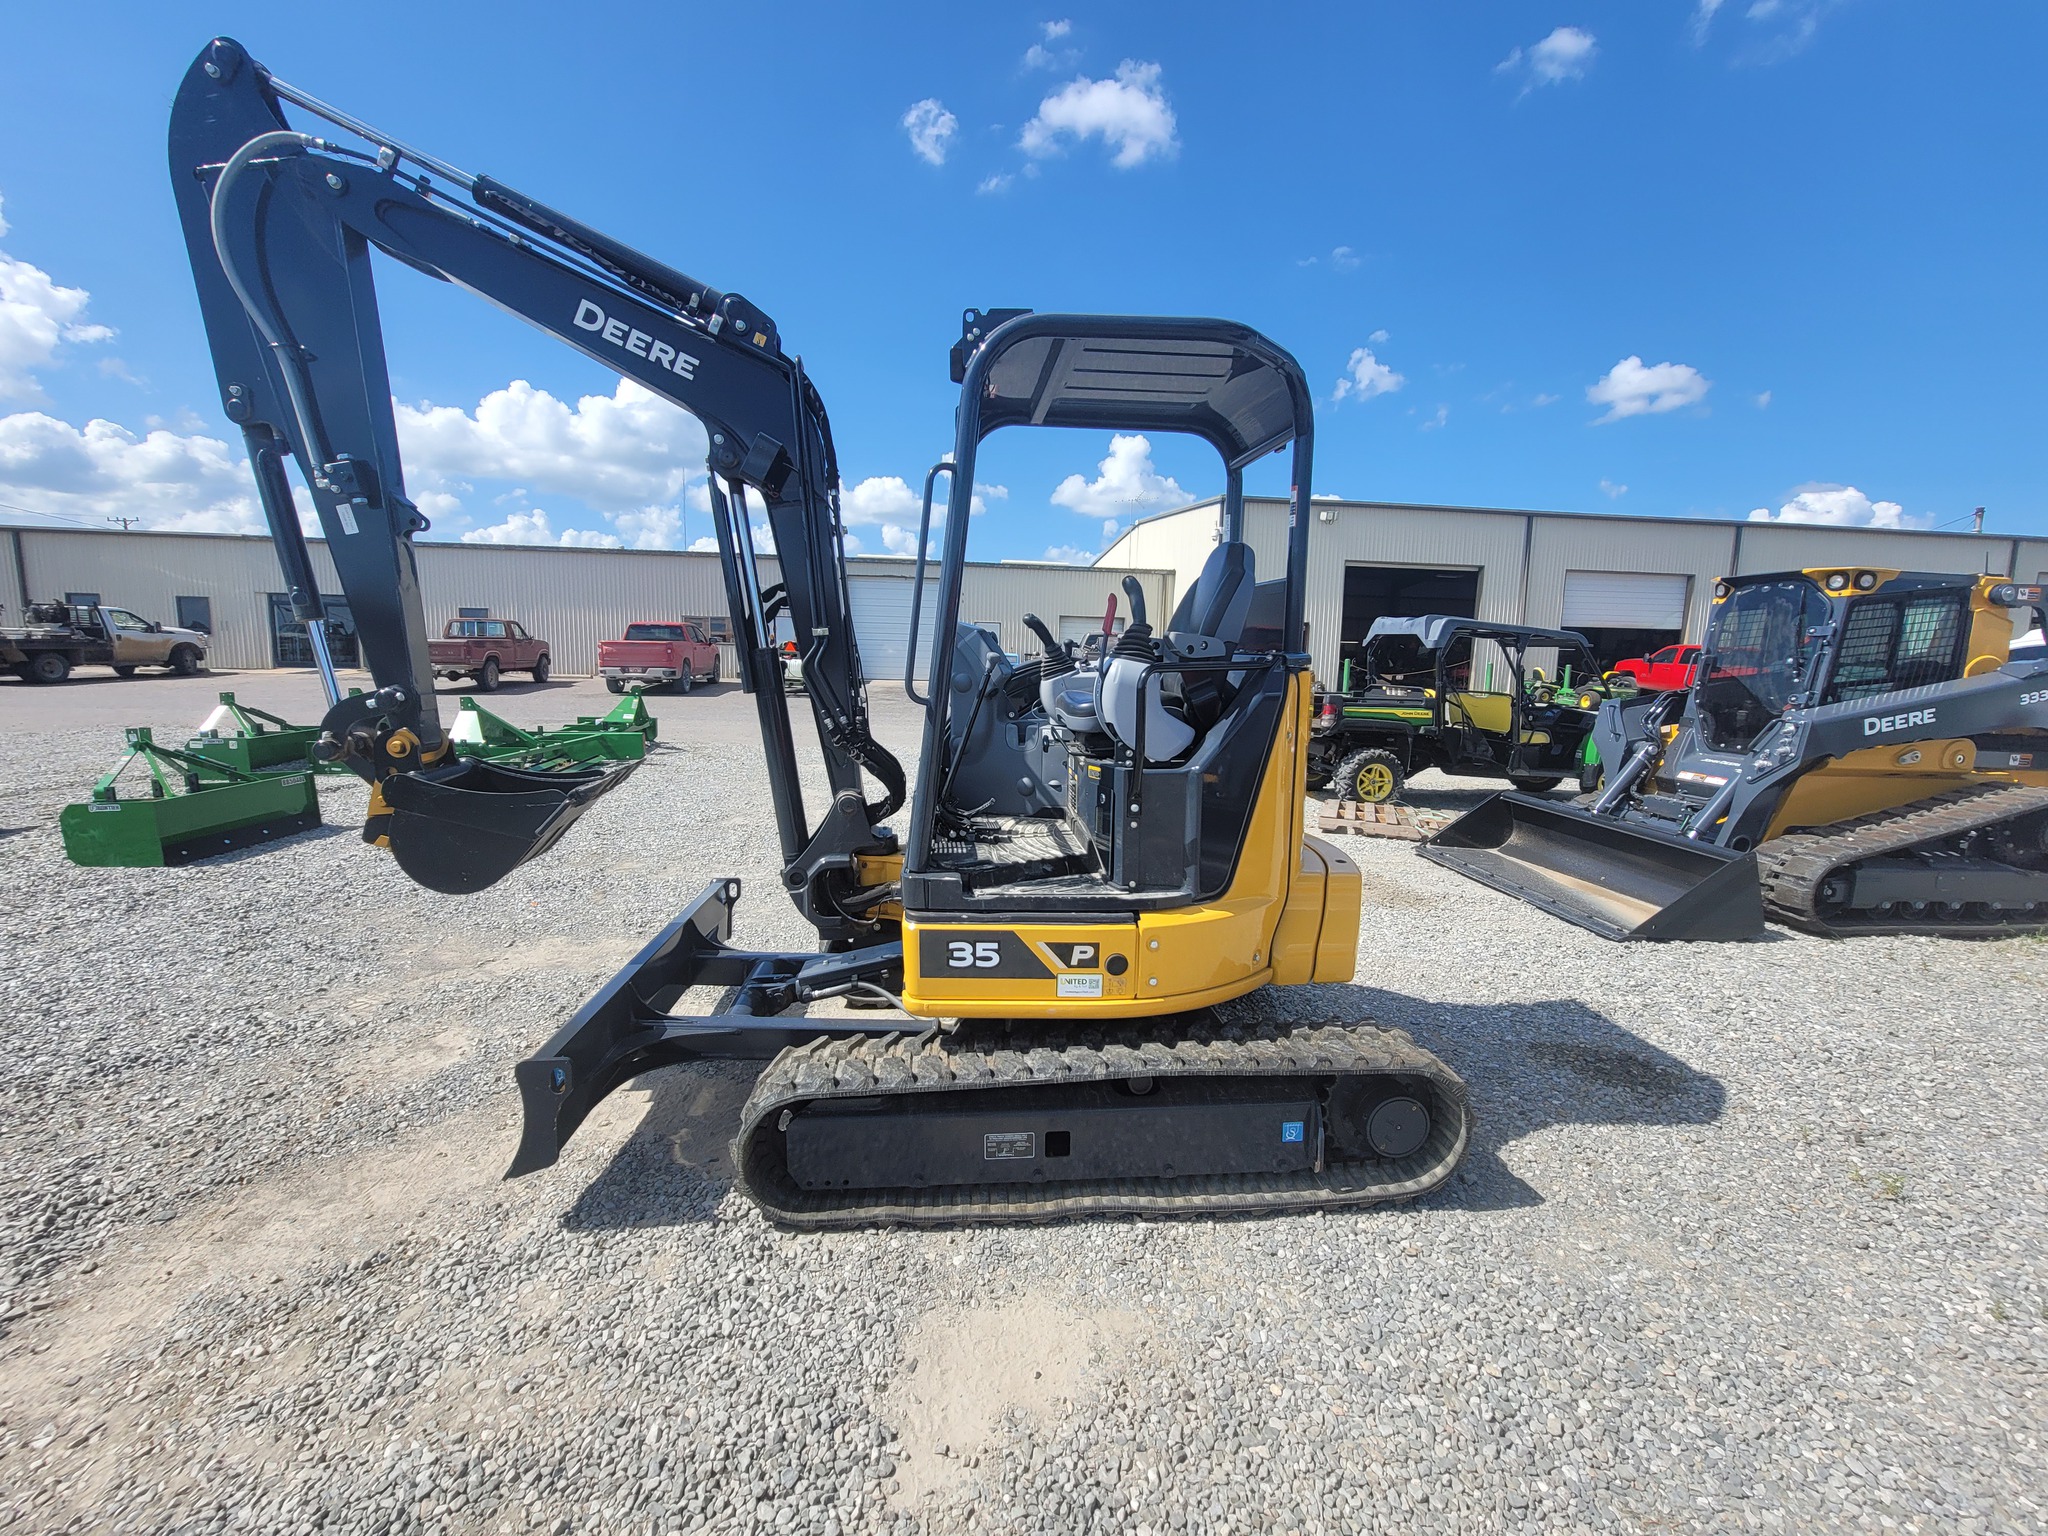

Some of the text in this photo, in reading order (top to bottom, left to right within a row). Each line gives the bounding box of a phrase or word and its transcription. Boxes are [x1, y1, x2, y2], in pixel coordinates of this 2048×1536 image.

[573, 299, 700, 380] DEERE
[2019, 689, 2048, 705] 333
[1863, 707, 1937, 736] DEERE
[948, 942, 1000, 967] 35
